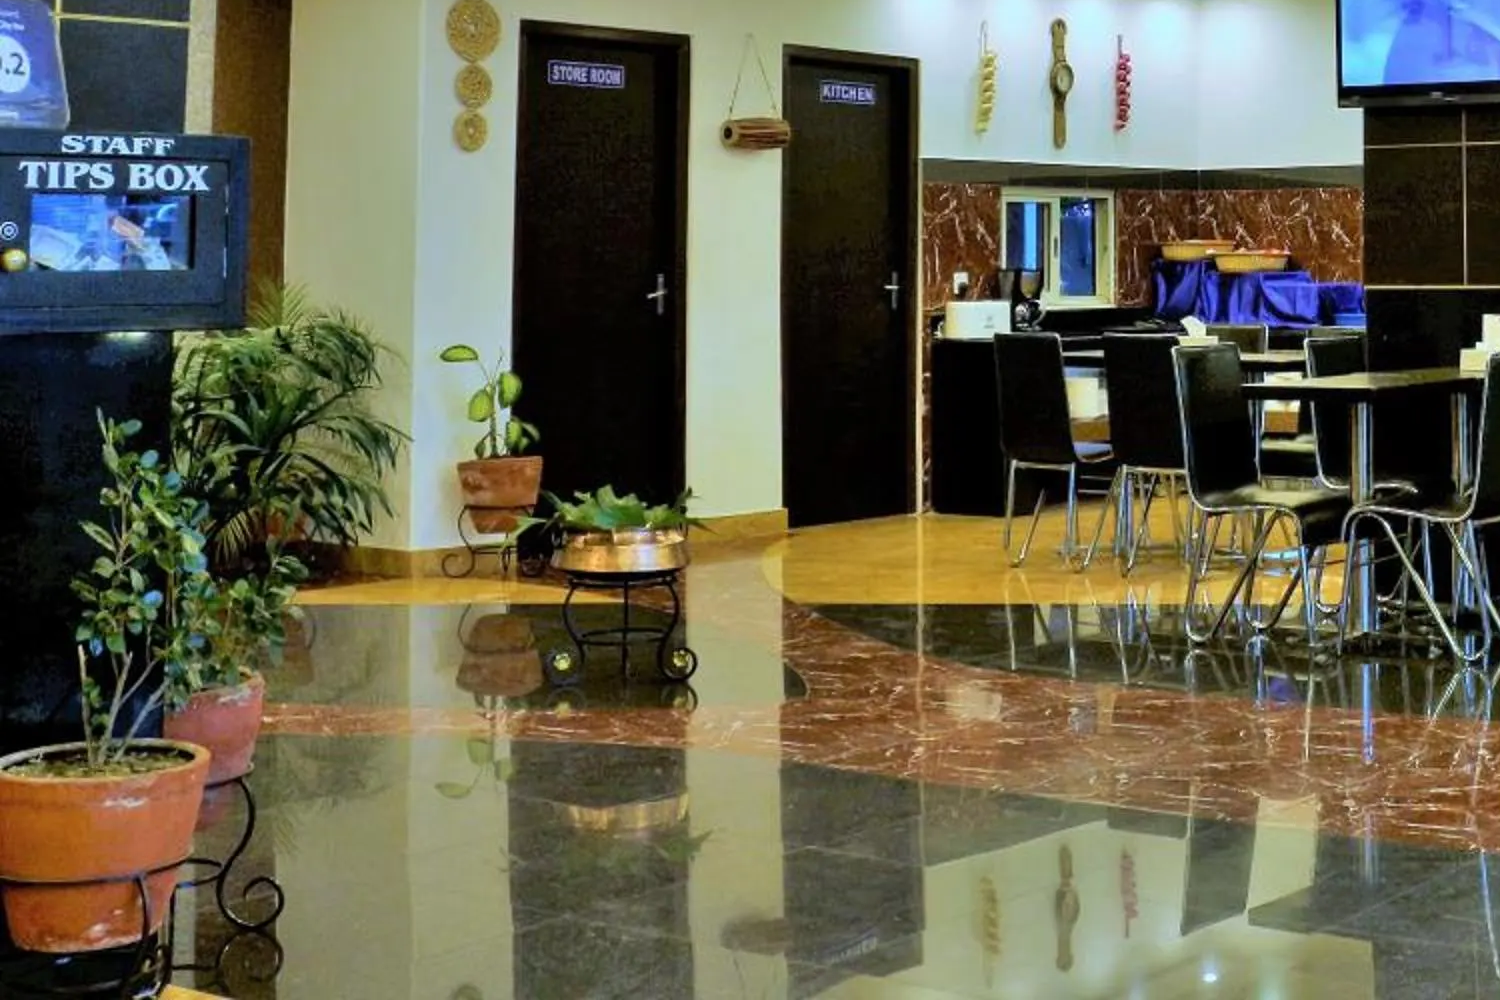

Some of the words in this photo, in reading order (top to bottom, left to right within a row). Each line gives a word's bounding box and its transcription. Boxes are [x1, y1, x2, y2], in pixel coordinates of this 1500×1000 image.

[0, 52, 26, 76] .2
[552, 63, 588, 82] STORE
[590, 67, 621, 85] ROOM
[823, 83, 873, 101] KITCHEN
[61, 135, 175, 156] STAFF
[18, 160, 115, 189] TIPS
[127, 163, 210, 191] BOX
